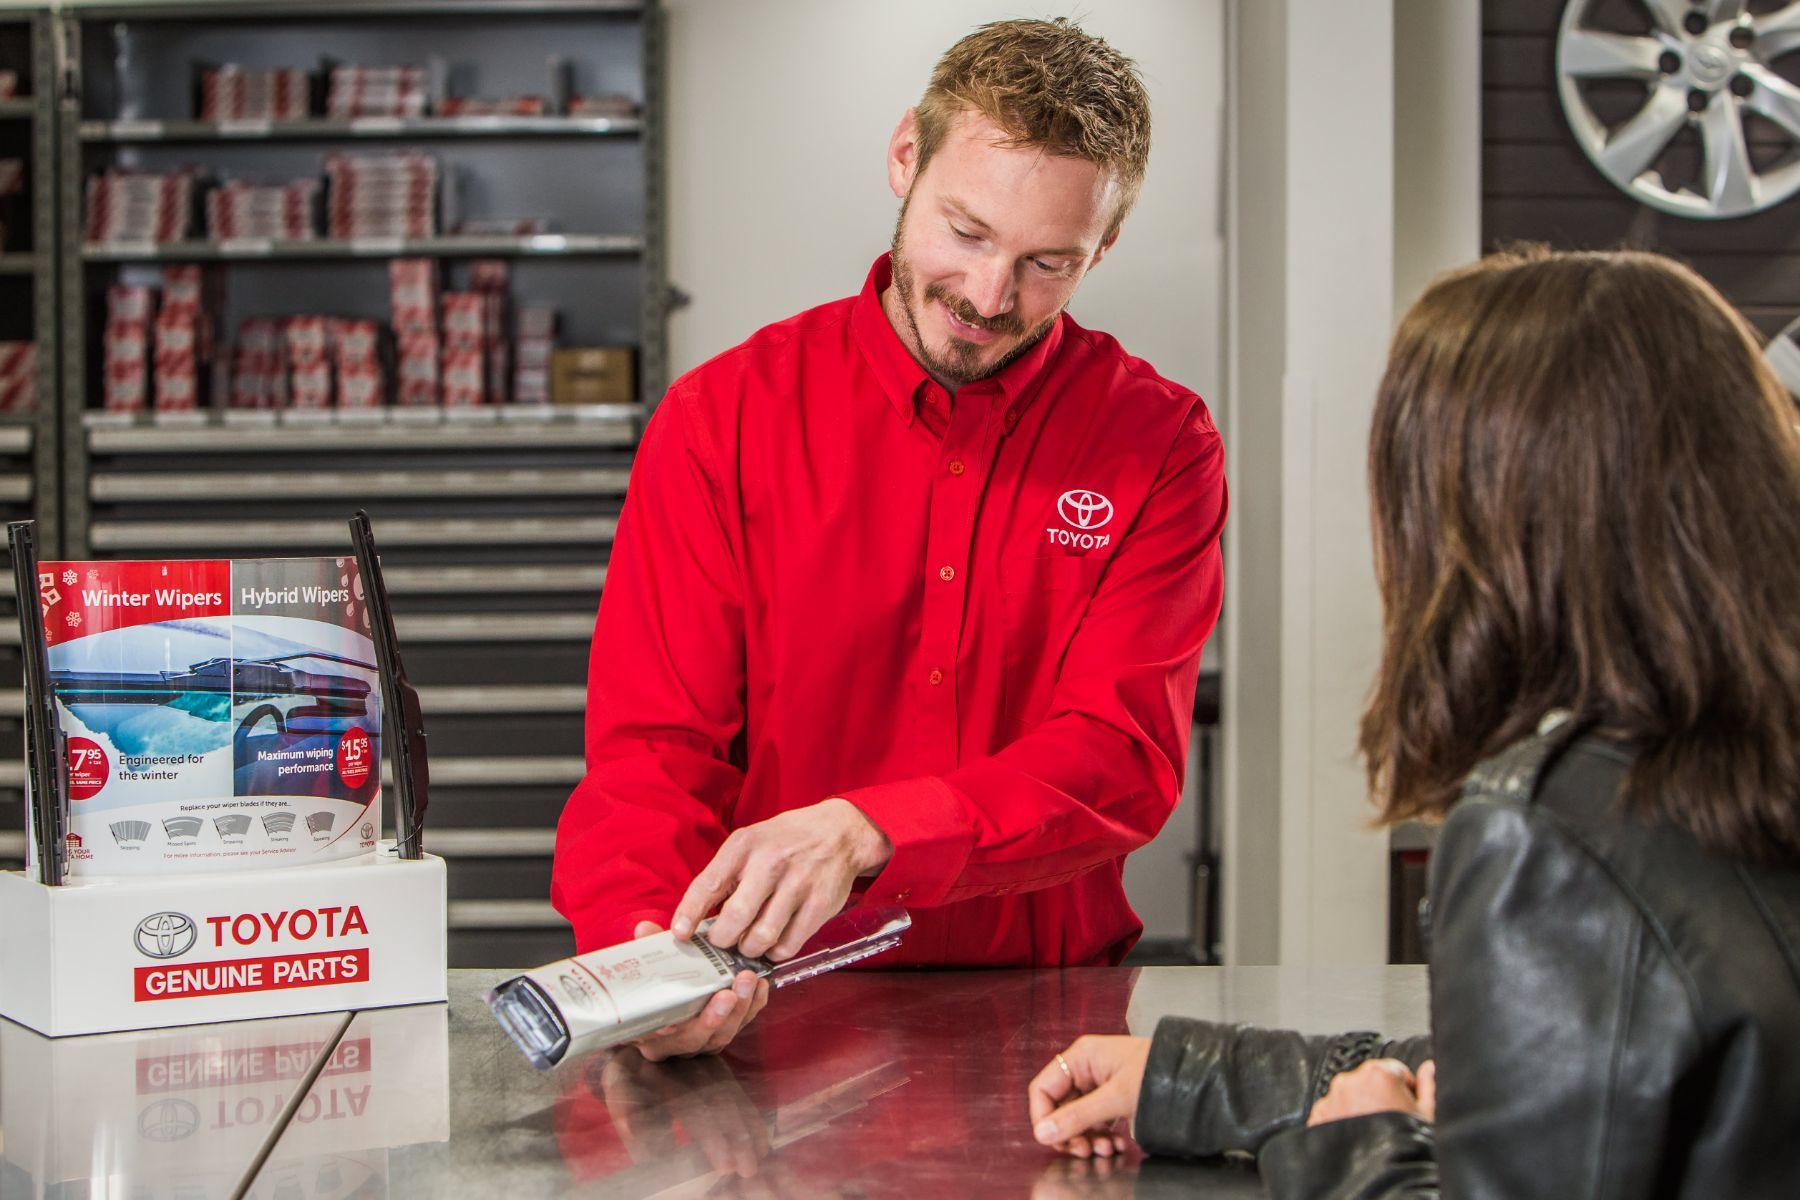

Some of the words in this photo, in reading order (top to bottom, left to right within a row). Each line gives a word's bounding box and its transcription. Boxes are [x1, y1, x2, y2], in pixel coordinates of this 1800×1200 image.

[1047, 528, 1110, 549] TOYOTA
[81, 589, 150, 607] Winter
[154, 589, 222, 610] Wipers
[241, 587, 298, 609] Hybrid
[302, 586, 349, 607] Wipers
[119, 754, 184, 767] Engineered
[188, 754, 204, 764] for
[257, 750, 304, 761] Maximum
[306, 748, 334, 760] wiping
[119, 771, 138, 780] the
[141, 771, 178, 780] winter
[278, 763, 334, 776] performance
[206, 803, 221, 811] your
[206, 905, 369, 947] TOYOTA
[145, 964, 263, 996] GENUINE
[273, 955, 358, 984] PARTS
